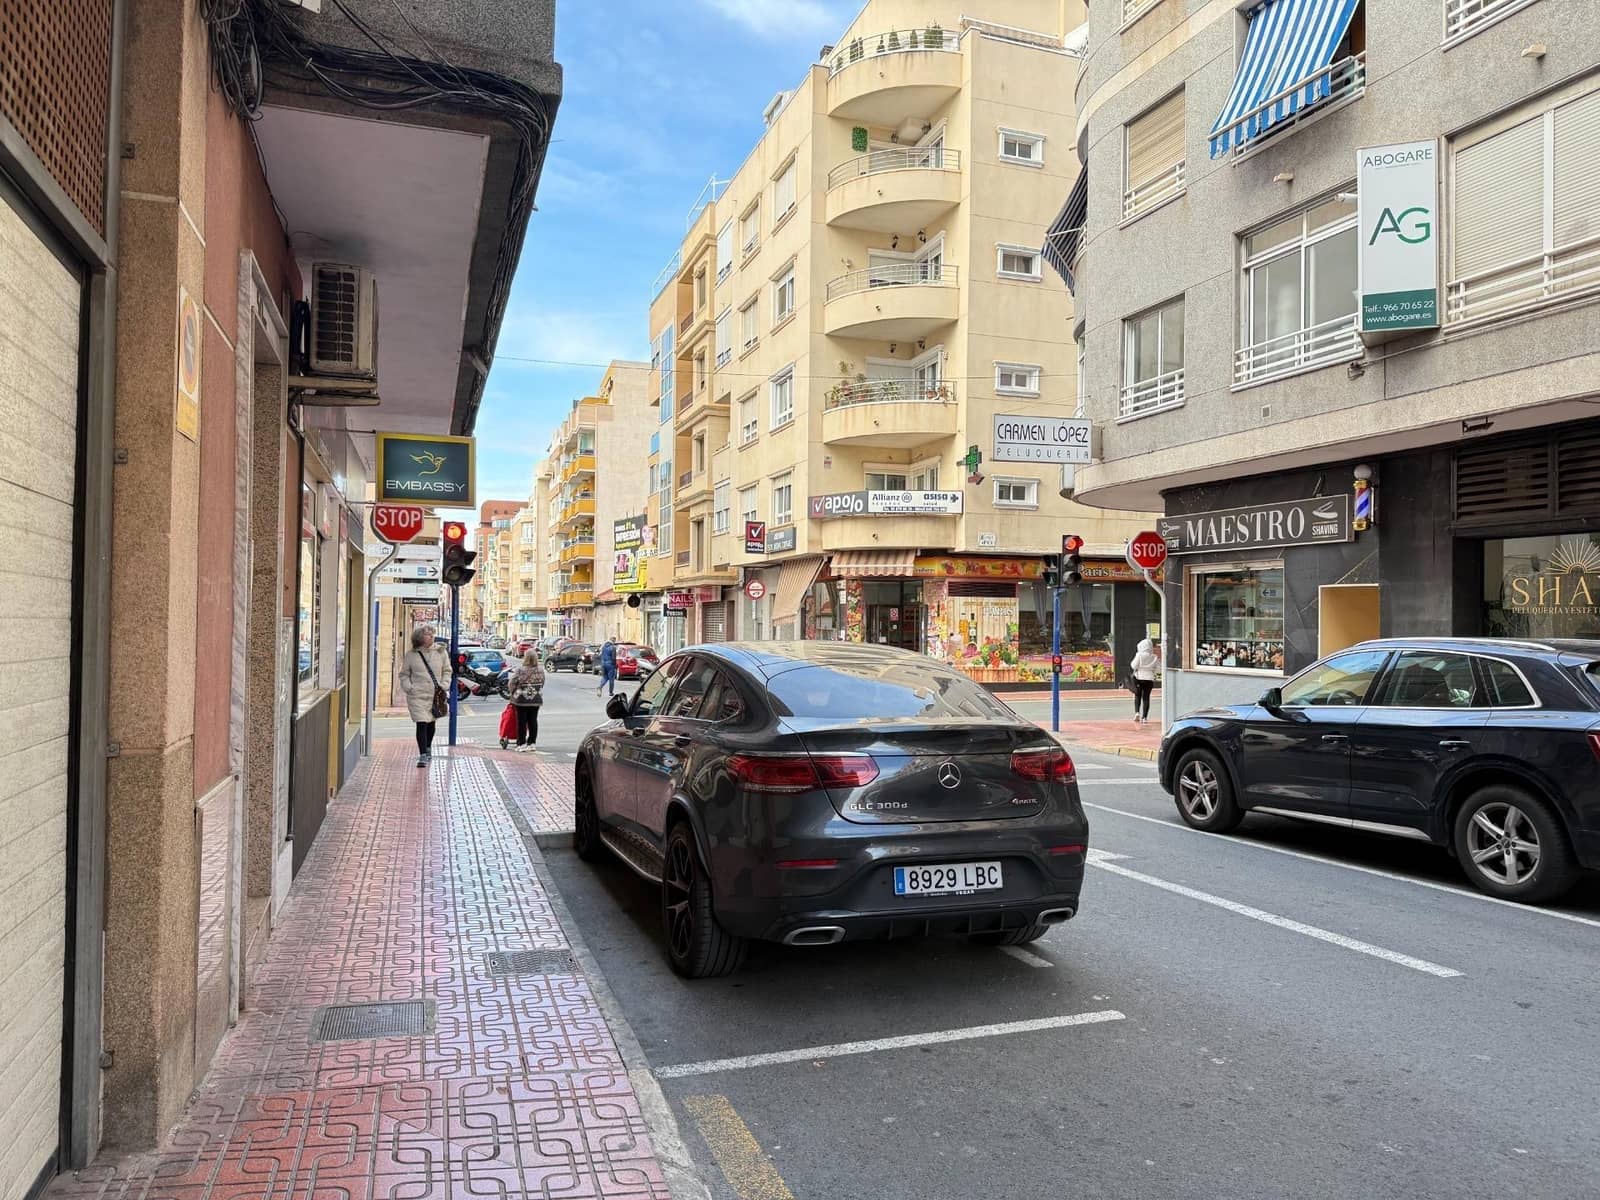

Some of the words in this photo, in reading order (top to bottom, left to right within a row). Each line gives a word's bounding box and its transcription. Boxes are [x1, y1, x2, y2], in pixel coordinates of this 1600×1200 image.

[1363, 148, 1433, 168] ABOGARE
[1368, 207, 1431, 246] AG
[1383, 303, 1399, 312] 966
[1400, 302, 1411, 310] 70
[1412, 301, 1422, 310] 65
[1424, 300, 1434, 309] 22
[1366, 312, 1432, 323] www.abogare.es
[997, 423, 1046, 441] CARMEN
[1052, 421, 1089, 443] LÓPEZ
[386, 479, 465, 492] EMBASSY
[825, 494, 863, 514] apolo
[872, 493, 900, 501] Allianz
[923, 493, 948, 501] asisa
[376, 508, 421, 529] STOP
[1185, 506, 1305, 548] MAESTRO
[1312, 524, 1338, 535] SHAVING
[1133, 542, 1165, 558] STOP
[669, 595, 693, 603] NAILS
[909, 868, 957, 890] 8929
[964, 865, 998, 887] LBC
